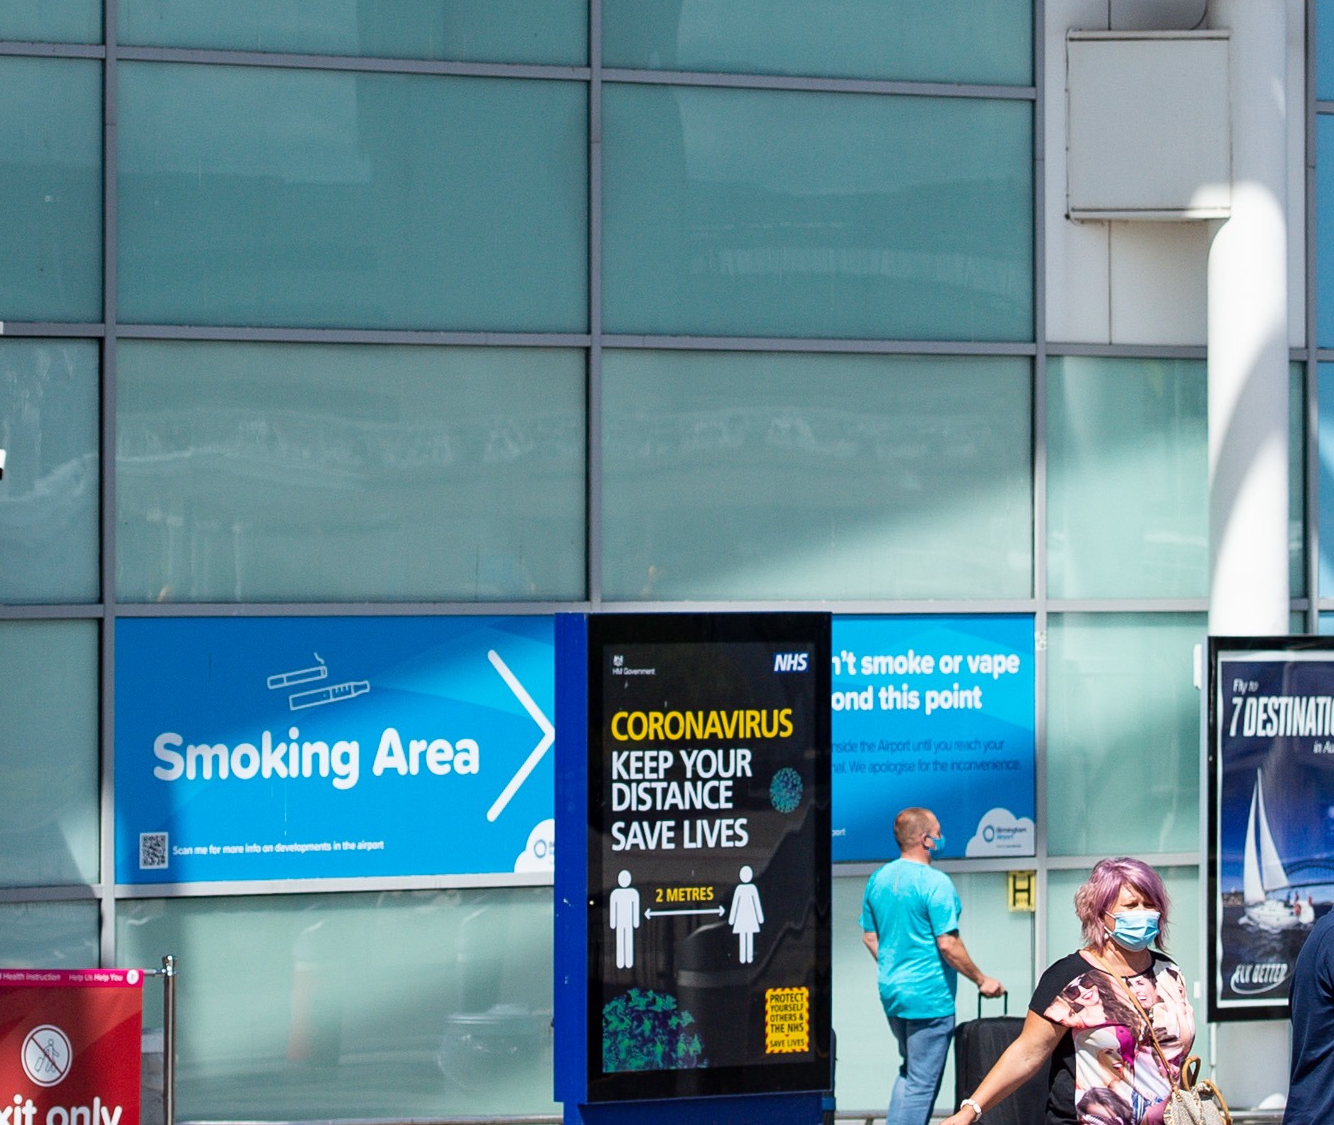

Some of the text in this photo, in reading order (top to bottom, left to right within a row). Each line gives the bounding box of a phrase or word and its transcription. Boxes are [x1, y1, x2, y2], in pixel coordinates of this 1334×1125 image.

[623, 667, 655, 675] Government
[774, 653, 808, 671] NHS
[861, 649, 935, 675] smoke
[939, 655, 963, 674] or
[967, 654, 1020, 680] vape
[1233, 678, 1259, 694] Fly to
[832, 682, 982, 715] ond this point
[611, 708, 793, 741] CORONAVIRUS
[1229, 697, 1243, 737] 7
[1313, 742, 1322, 754] in
[154, 727, 479, 790] Smoking Area
[612, 749, 752, 780] KEEP YOUR
[612, 780, 733, 811] DISTANCE
[612, 818, 749, 851] SAVE LIVES
[173, 840, 384, 855] Scan me for more info on developments in the airport
[656, 887, 714, 902] 2 METRES
[1013, 875, 1031, 907] H
[770, 993, 804, 1003] PROTECT
[771, 1004, 803, 1012] YOURSELF
[770, 1013, 797, 1022] OTHERS
[770, 1023, 804, 1033] THE NHS
